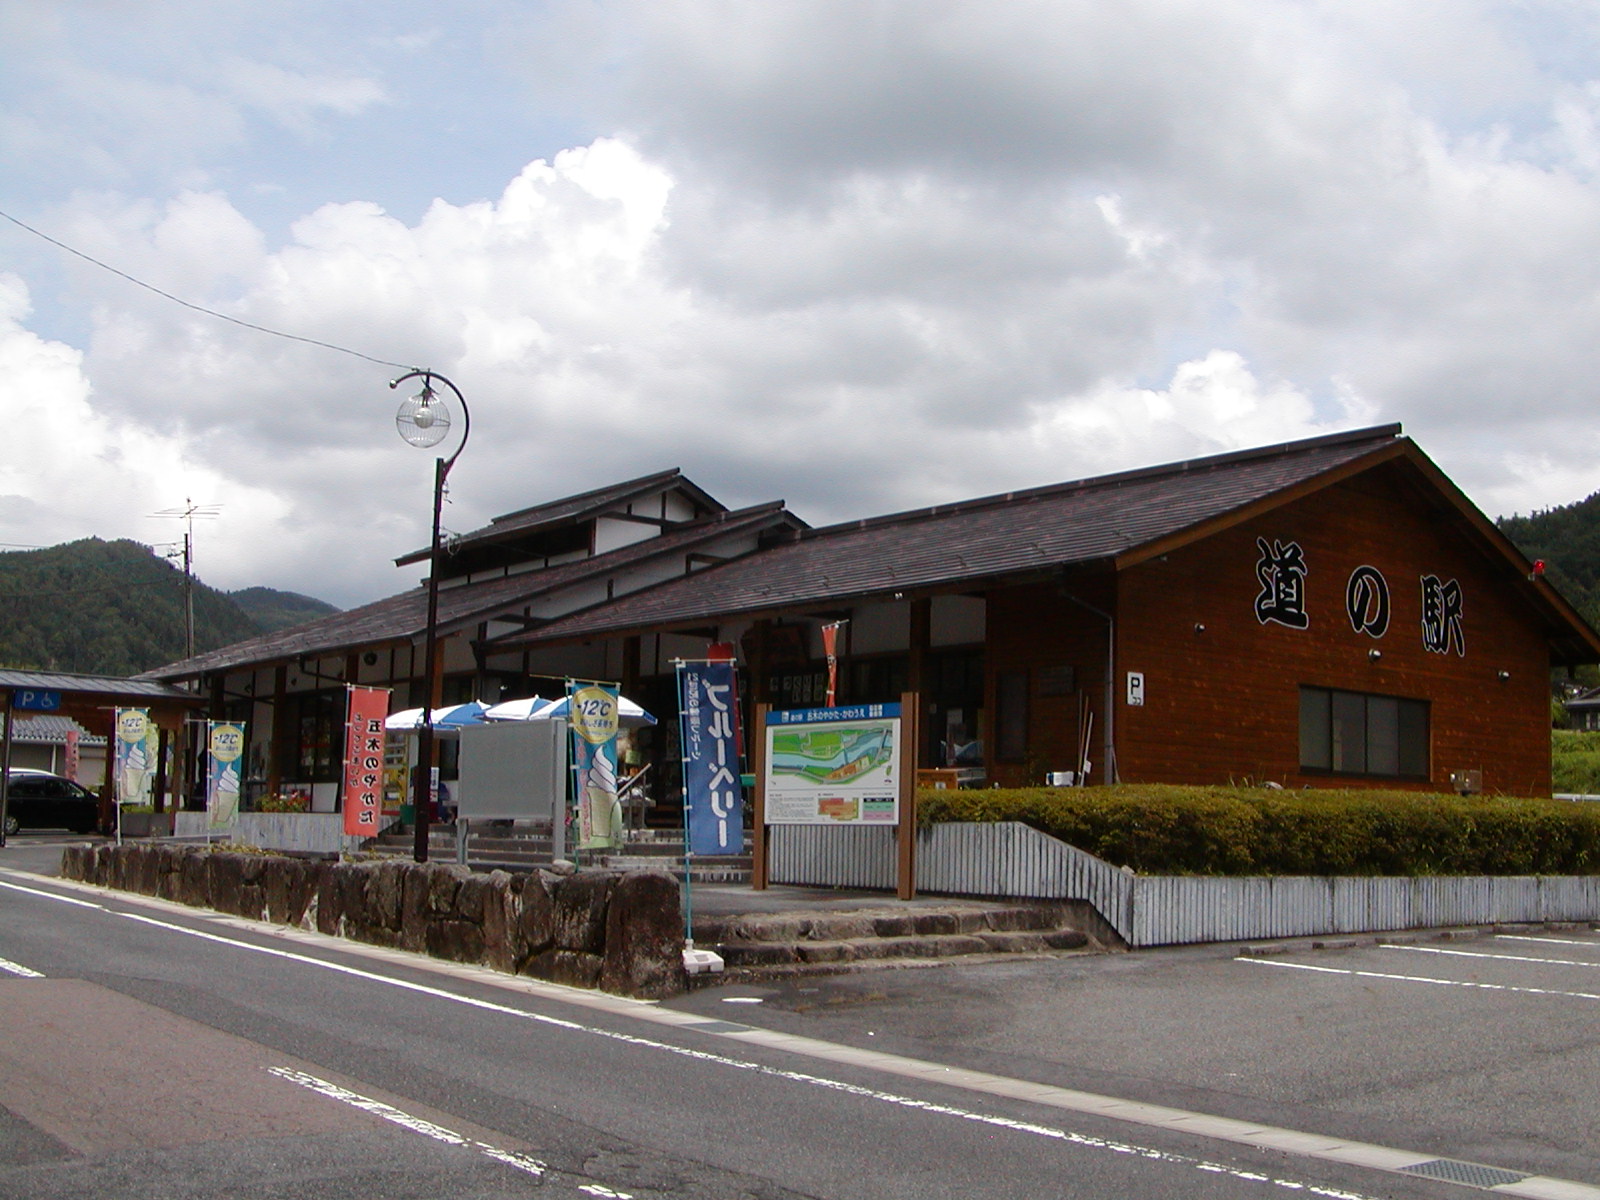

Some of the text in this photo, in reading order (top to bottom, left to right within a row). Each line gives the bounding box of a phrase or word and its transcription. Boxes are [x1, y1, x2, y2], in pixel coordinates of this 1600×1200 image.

[1254, 536, 1466, 658] 道の駅
[1130, 676, 1141, 696] P
[21, 692, 34, 706] P
